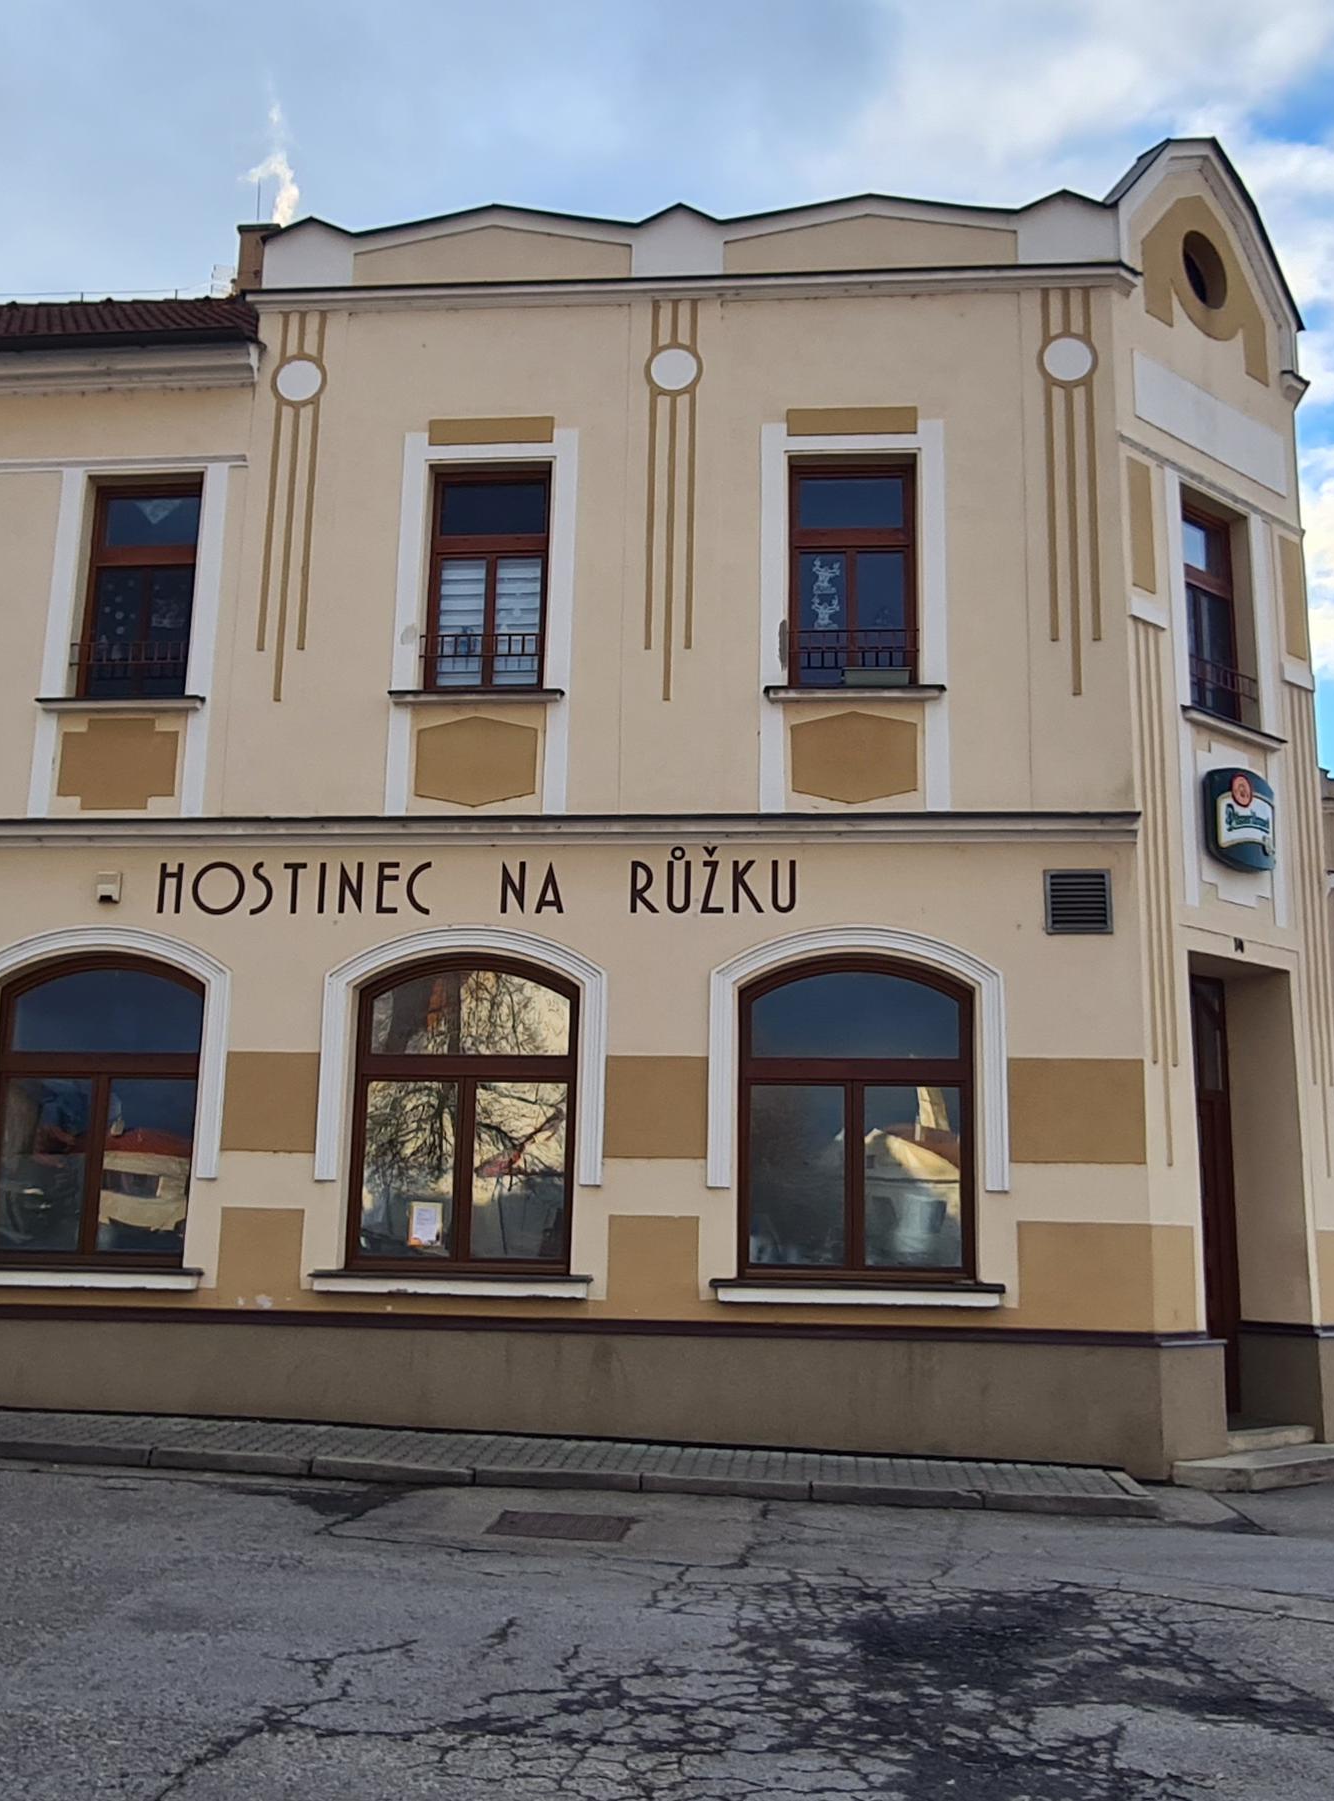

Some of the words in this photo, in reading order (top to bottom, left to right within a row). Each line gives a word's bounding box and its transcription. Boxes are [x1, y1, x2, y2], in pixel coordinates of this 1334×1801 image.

[156, 861, 434, 916] HOSTINEC
[500, 860, 564, 914] NA
[630, 845, 797, 914] RŮŽKU
